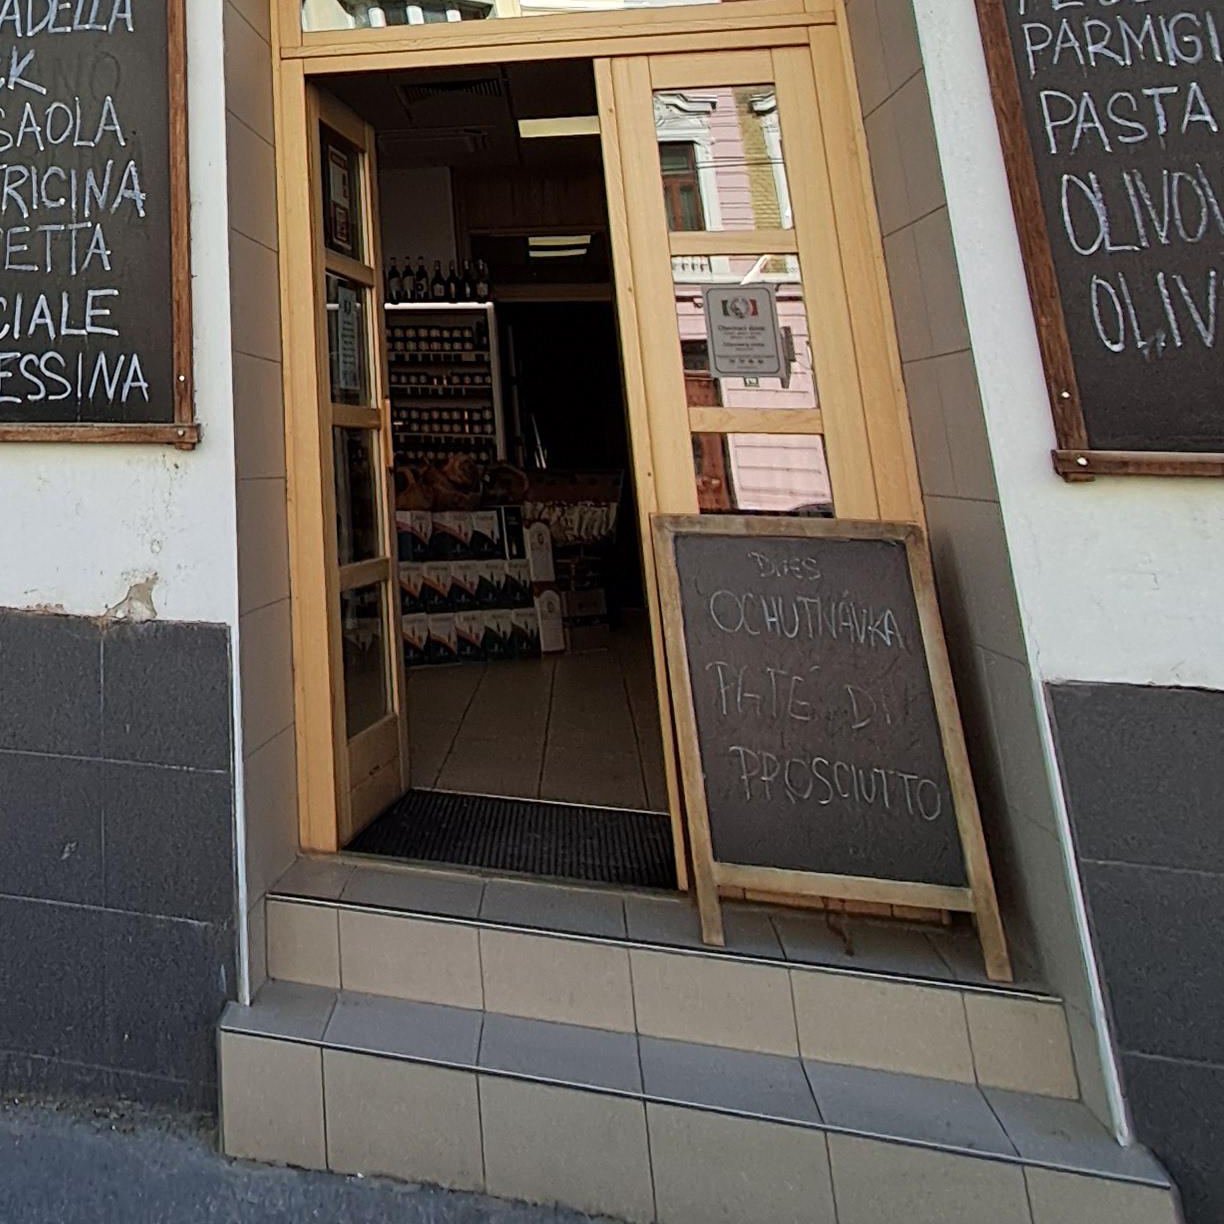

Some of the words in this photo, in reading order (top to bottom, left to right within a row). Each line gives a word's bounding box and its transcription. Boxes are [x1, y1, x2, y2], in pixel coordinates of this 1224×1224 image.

[1022, 11, 1223, 80] PARMIGI
[1040, 82, 1219, 155] PASTA
[709, 590, 905, 650] OCHUTNÁVKA
[844, 683, 892, 730] DI
[728, 745, 942, 821] PROSCIUTTO
